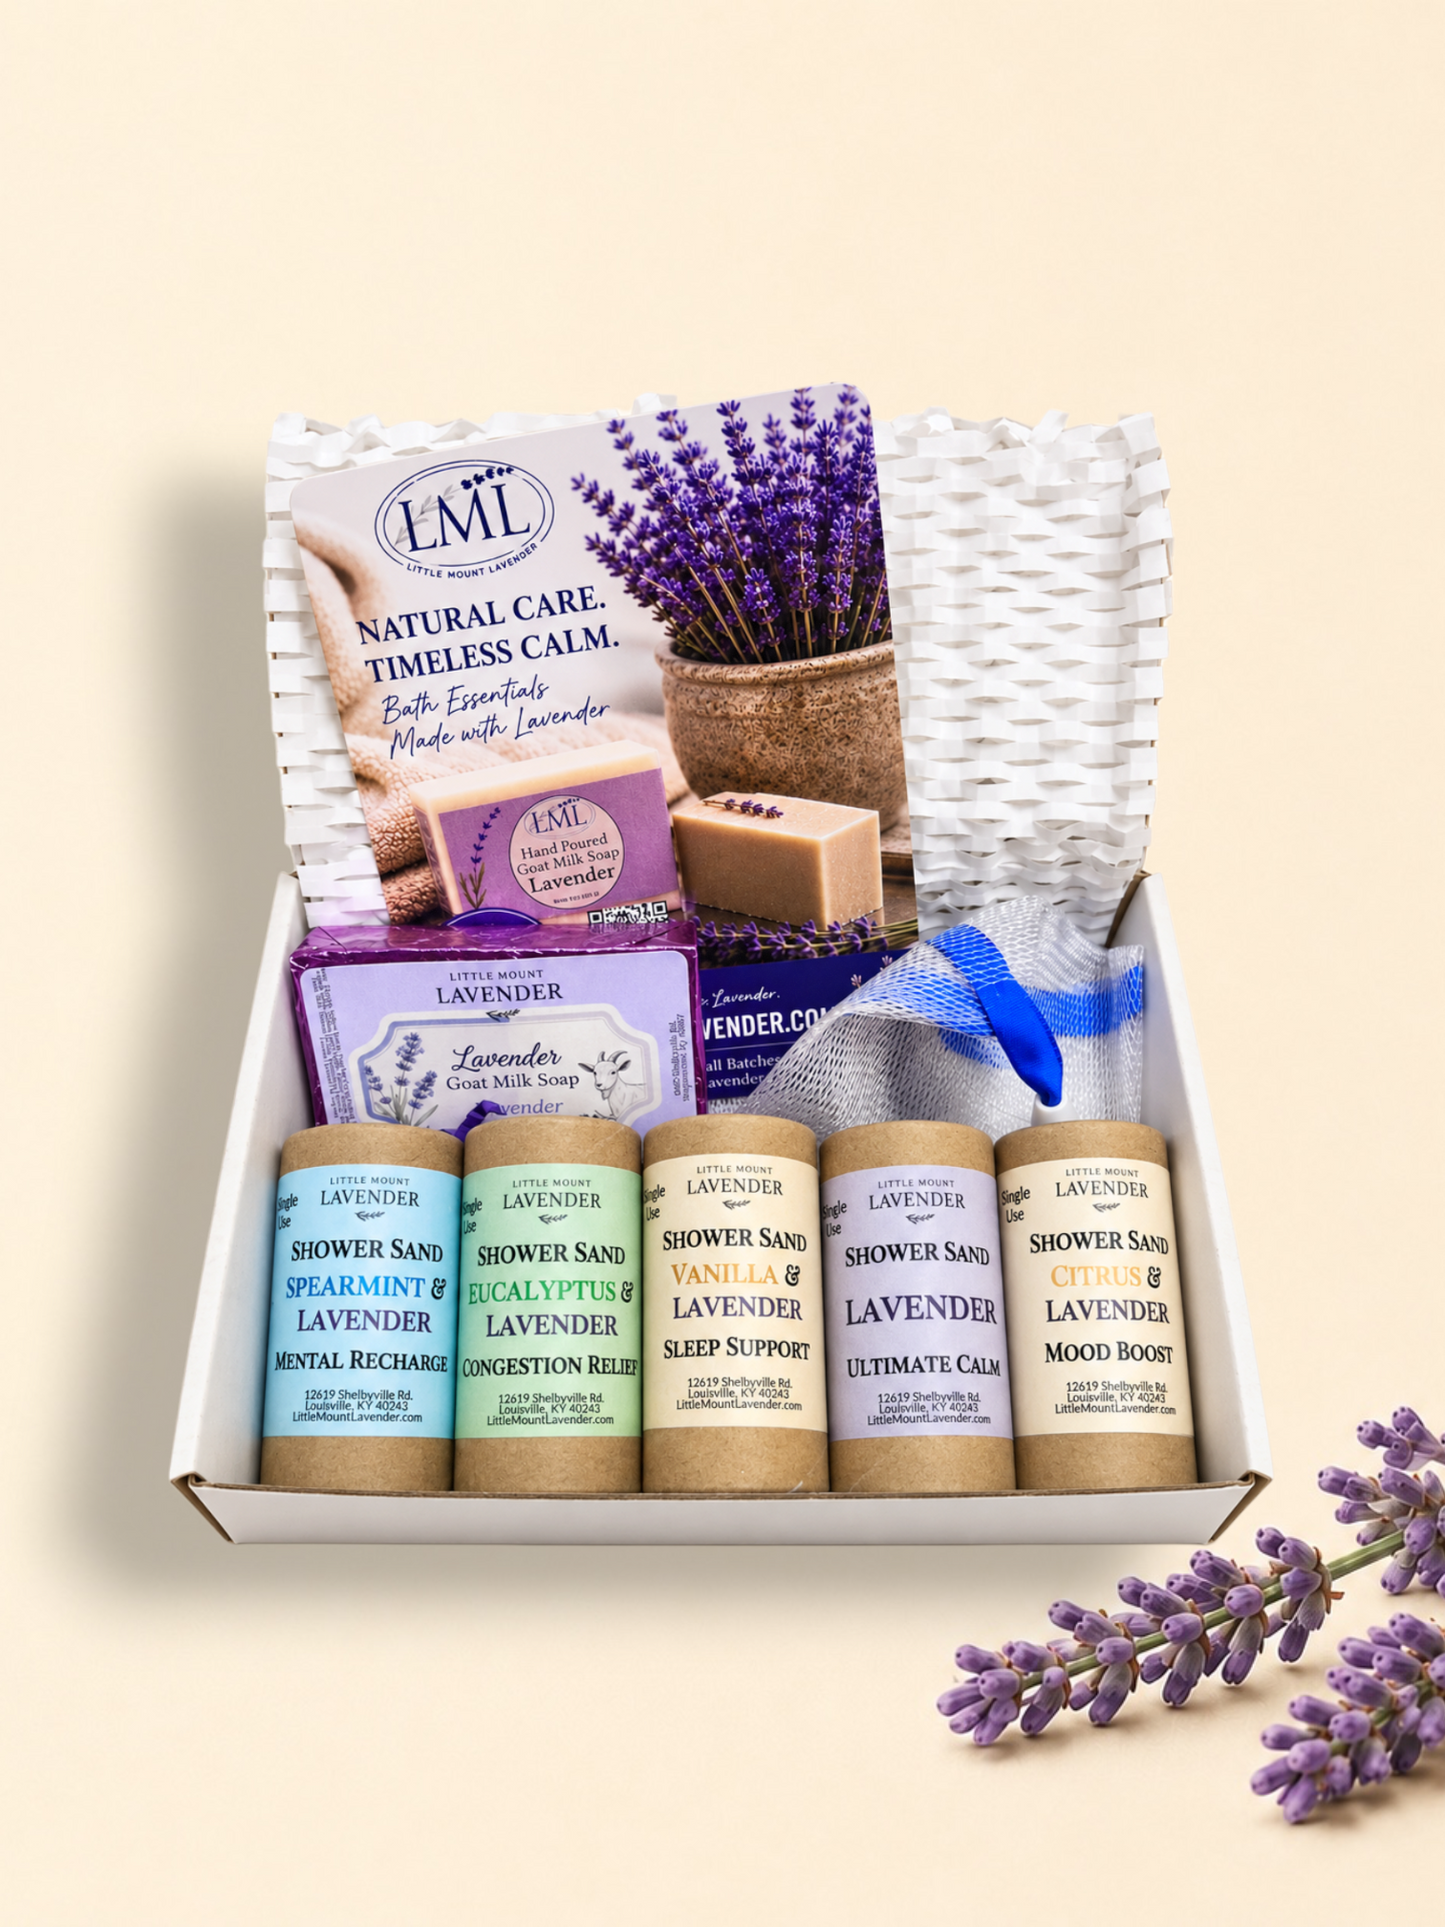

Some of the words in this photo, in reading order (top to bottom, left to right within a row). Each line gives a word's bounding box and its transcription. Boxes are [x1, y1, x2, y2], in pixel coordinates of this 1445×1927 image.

[398, 483, 530, 552] LML
[406, 562, 442, 579] LITTLE
[448, 567, 485, 579] MOUNT
[489, 542, 537, 574] LAVENDER
[356, 601, 505, 645] NATURAL
[513, 586, 606, 621] CARE.
[365, 639, 513, 683] TIMELESS
[521, 624, 619, 660] CALM.
[382, 691, 439, 725] Bath
[447, 674, 549, 716] Essentials
[390, 723, 455, 759] Made
[462, 714, 507, 743] with
[514, 696, 610, 739] Lavender
[532, 805, 587, 834] LML
[521, 843, 558, 860] Hand
[561, 833, 608, 852] Poured
[517, 862, 550, 876] Goat
[553, 854, 584, 869] Milk
[587, 848, 619, 865] Soap
[528, 865, 616, 893] Lavender
[449, 972, 493, 981] LITTLE
[499, 970, 544, 980] MOUNT
[436, 982, 563, 1004] LAVENDER
[712, 986, 780, 1008] Lavender.
[703, 1007, 827, 1040] VENDER.CO
[451, 1043, 562, 1072] Lavender
[706, 1059, 722, 1072] all
[727, 1055, 782, 1070] Batches
[447, 1076, 489, 1091] Goat
[493, 1073, 533, 1088] Milk
[538, 1071, 579, 1089] Soap
[708, 1074, 764, 1088] avender
[475, 1099, 563, 1115] vender
[697, 1166, 731, 1174] LITTLE
[736, 1166, 773, 1174] MOUNT
[1105, 1169, 1139, 1177] MOUNT
[330, 1177, 367, 1185] LITTLE
[371, 1177, 410, 1186] MOUNT
[513, 1179, 549, 1188] LITTLE
[553, 1179, 591, 1188] MOUNT
[687, 1178, 783, 1195] LAVENDER
[878, 1180, 915, 1188] LITTLE
[918, 1179, 954, 1188] MOUNT
[1056, 1181, 1148, 1198] LAVENDER
[278, 1194, 298, 1212] Single
[320, 1190, 419, 1207] LAVENDER
[503, 1193, 601, 1209] LAVENDER
[643, 1184, 665, 1203] Single
[869, 1192, 965, 1210] LAVENDER
[1002, 1186, 1030, 1206] Single
[463, 1198, 482, 1216] Single
[646, 1207, 660, 1221] Use
[823, 1201, 847, 1220] Single
[1006, 1209, 1024, 1223] Use
[278, 1216, 291, 1230] Use
[464, 1220, 476, 1234] Use
[826, 1222, 841, 1237] Use
[663, 1228, 753, 1251] SHOWER
[759, 1227, 806, 1252] SAND
[1030, 1232, 1124, 1254] SHOWER
[1128, 1230, 1168, 1254] SAND
[291, 1240, 384, 1261] SHOWER
[390, 1238, 443, 1263] SAND
[477, 1244, 568, 1266] SHOWER
[574, 1242, 625, 1265] SAND
[845, 1243, 939, 1267] SHOWER
[944, 1242, 990, 1266] SAND
[671, 1263, 779, 1285] VANILLA
[785, 1265, 800, 1286] &
[1051, 1265, 1142, 1287] CITRUS
[1147, 1266, 1161, 1288] &
[286, 1276, 425, 1299] SPEARMINT
[431, 1278, 446, 1299] &
[469, 1280, 616, 1304] EUCALYPTUS
[621, 1281, 633, 1303] &
[673, 1296, 802, 1320] LAVENDER
[845, 1295, 997, 1326] LAVENDER
[1045, 1300, 1169, 1324] LAVENDER
[297, 1309, 432, 1333] LAVENDER
[486, 1315, 618, 1337] LAVENDER
[664, 1338, 720, 1360] SLEEP
[726, 1337, 810, 1360] SUPPORT
[1045, 1343, 1111, 1363] MOOD
[1116, 1342, 1173, 1363] BOOST
[275, 1351, 343, 1371] MENTAL
[349, 1350, 448, 1372] RECHARGE
[463, 1356, 582, 1377] CONGESTION
[588, 1355, 638, 1376] RELIEF
[847, 1356, 951, 1378] ULTIMATE
[956, 1355, 1001, 1377] CALM
[688, 1378, 718, 1388] 12619
[721, 1378, 776, 1389] Shelbyville
[778, 1379, 793, 1389] Rd.
[1067, 1382, 1098, 1392] 12619
[1101, 1382, 1153, 1394] Shelbyville
[1156, 1383, 1168, 1393] Rd.
[305, 1390, 336, 1400] 12619
[338, 1390, 395, 1402] Shelbyville
[398, 1390, 413, 1400] Rd.
[499, 1393, 529, 1404] 12619
[532, 1393, 588, 1405] Shelbyville
[590, 1393, 604, 1404] Rd.
[688, 1389, 737, 1400] Louisville,
[741, 1389, 756, 1398] KY
[758, 1389, 789, 1399] 40243
[878, 1392, 910, 1404] 12619
[913, 1392, 965, 1405] Shelbyville
[967, 1392, 981, 1402] Rd.
[1067, 1393, 1118, 1403] Louisville,
[1120, 1393, 1135, 1402] KY
[1137, 1393, 1165, 1403] 40243
[305, 1401, 354, 1412] Louisville,
[357, 1402, 373, 1411] KY
[375, 1401, 408, 1411] 40243
[499, 1404, 547, 1415] Louisville,
[551, 1404, 567, 1414] KY
[569, 1404, 600, 1414] 40243
[676, 1399, 802, 1411] LittleMountLavender.com
[879, 1404, 929, 1414] Louisville,
[932, 1403, 947, 1413] KY
[949, 1403, 978, 1413] 40243
[1055, 1403, 1176, 1415] LittleMountLavender.com
[293, 1411, 422, 1423] LittleMountLavender.com
[487, 1414, 614, 1426] LittleMountLavender.com
[867, 1413, 991, 1425] LittleMountLavender.com
